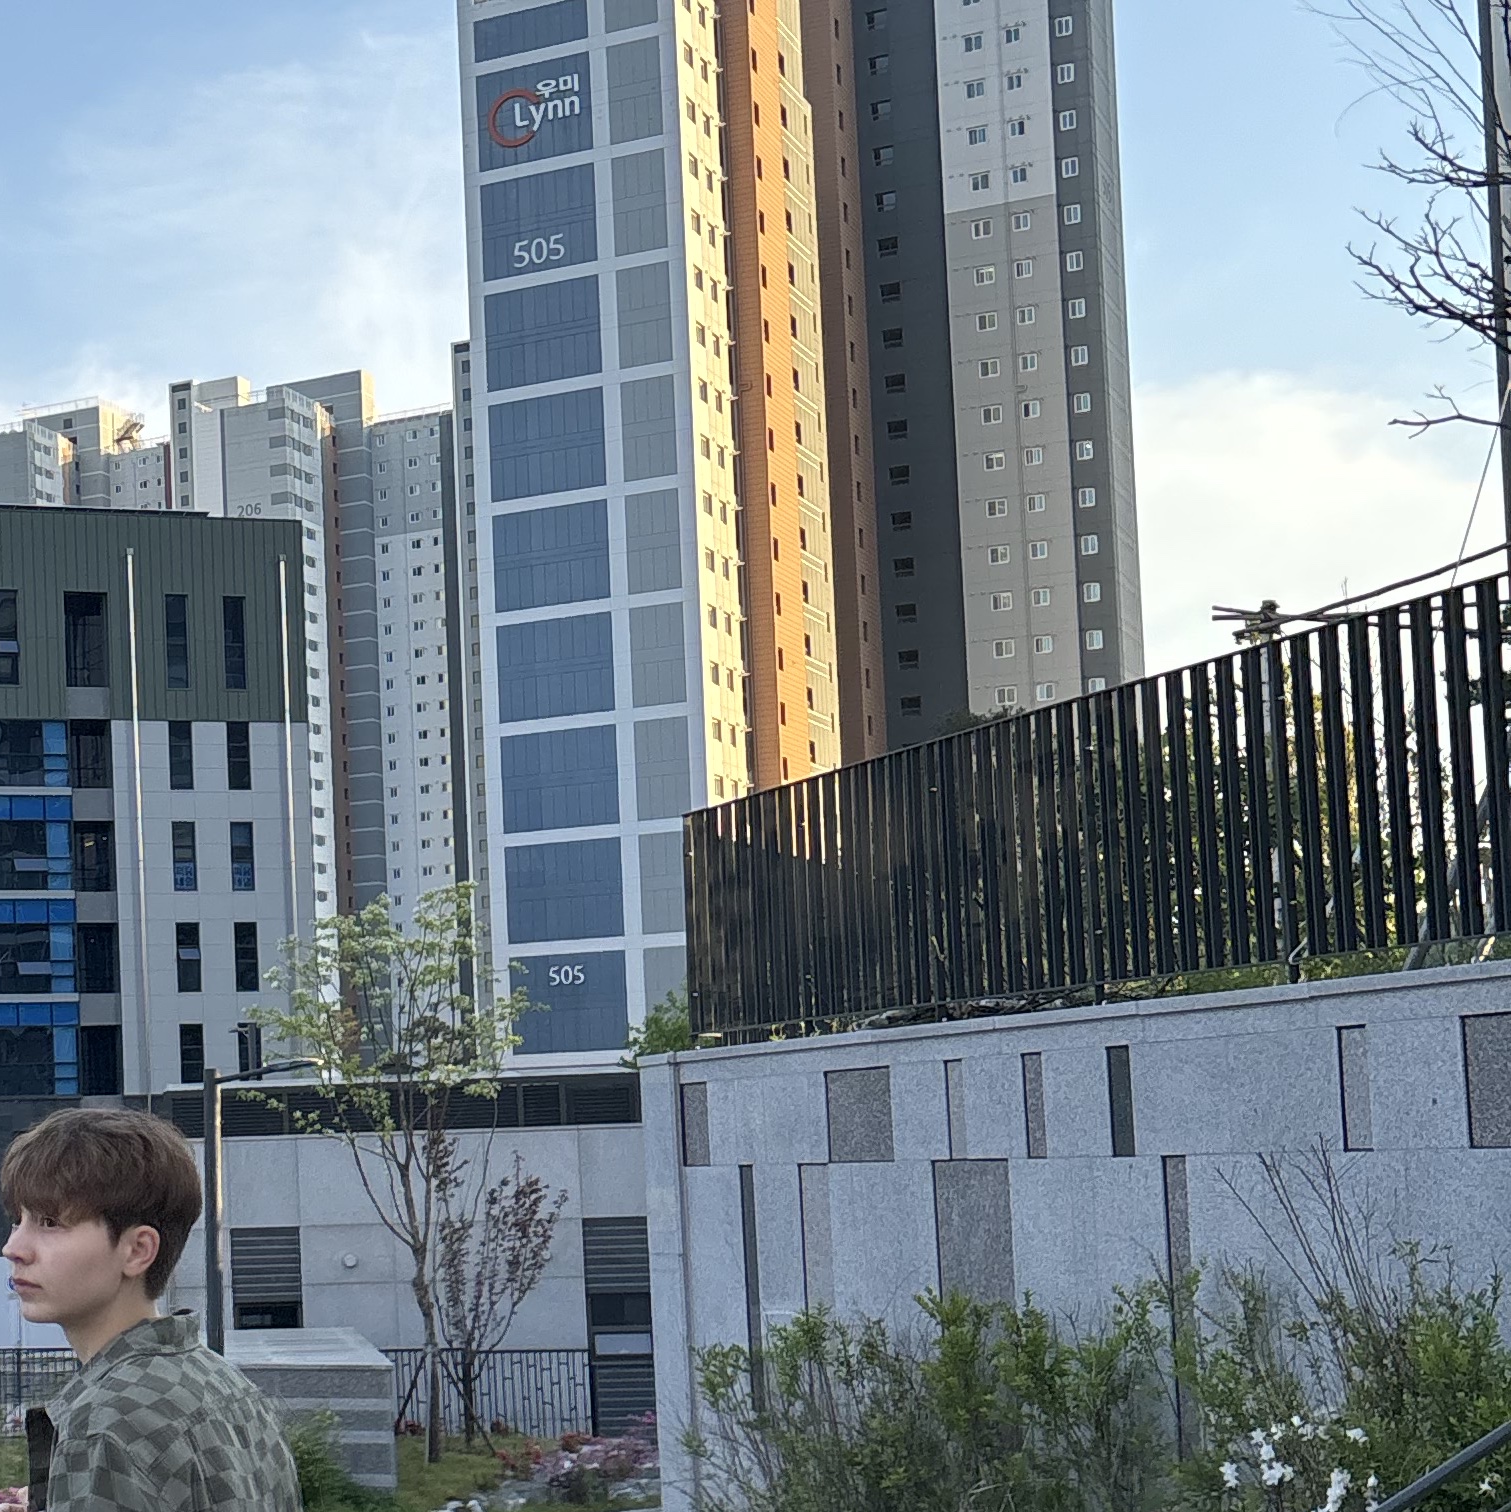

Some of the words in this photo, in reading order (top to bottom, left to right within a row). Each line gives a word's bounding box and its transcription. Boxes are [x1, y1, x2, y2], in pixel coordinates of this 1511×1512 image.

[535, 73, 580, 98] 우미
[514, 95, 581, 131] Lynn
[513, 233, 565, 268] 505
[237, 502, 262, 517] 206
[549, 964, 585, 986] 505
